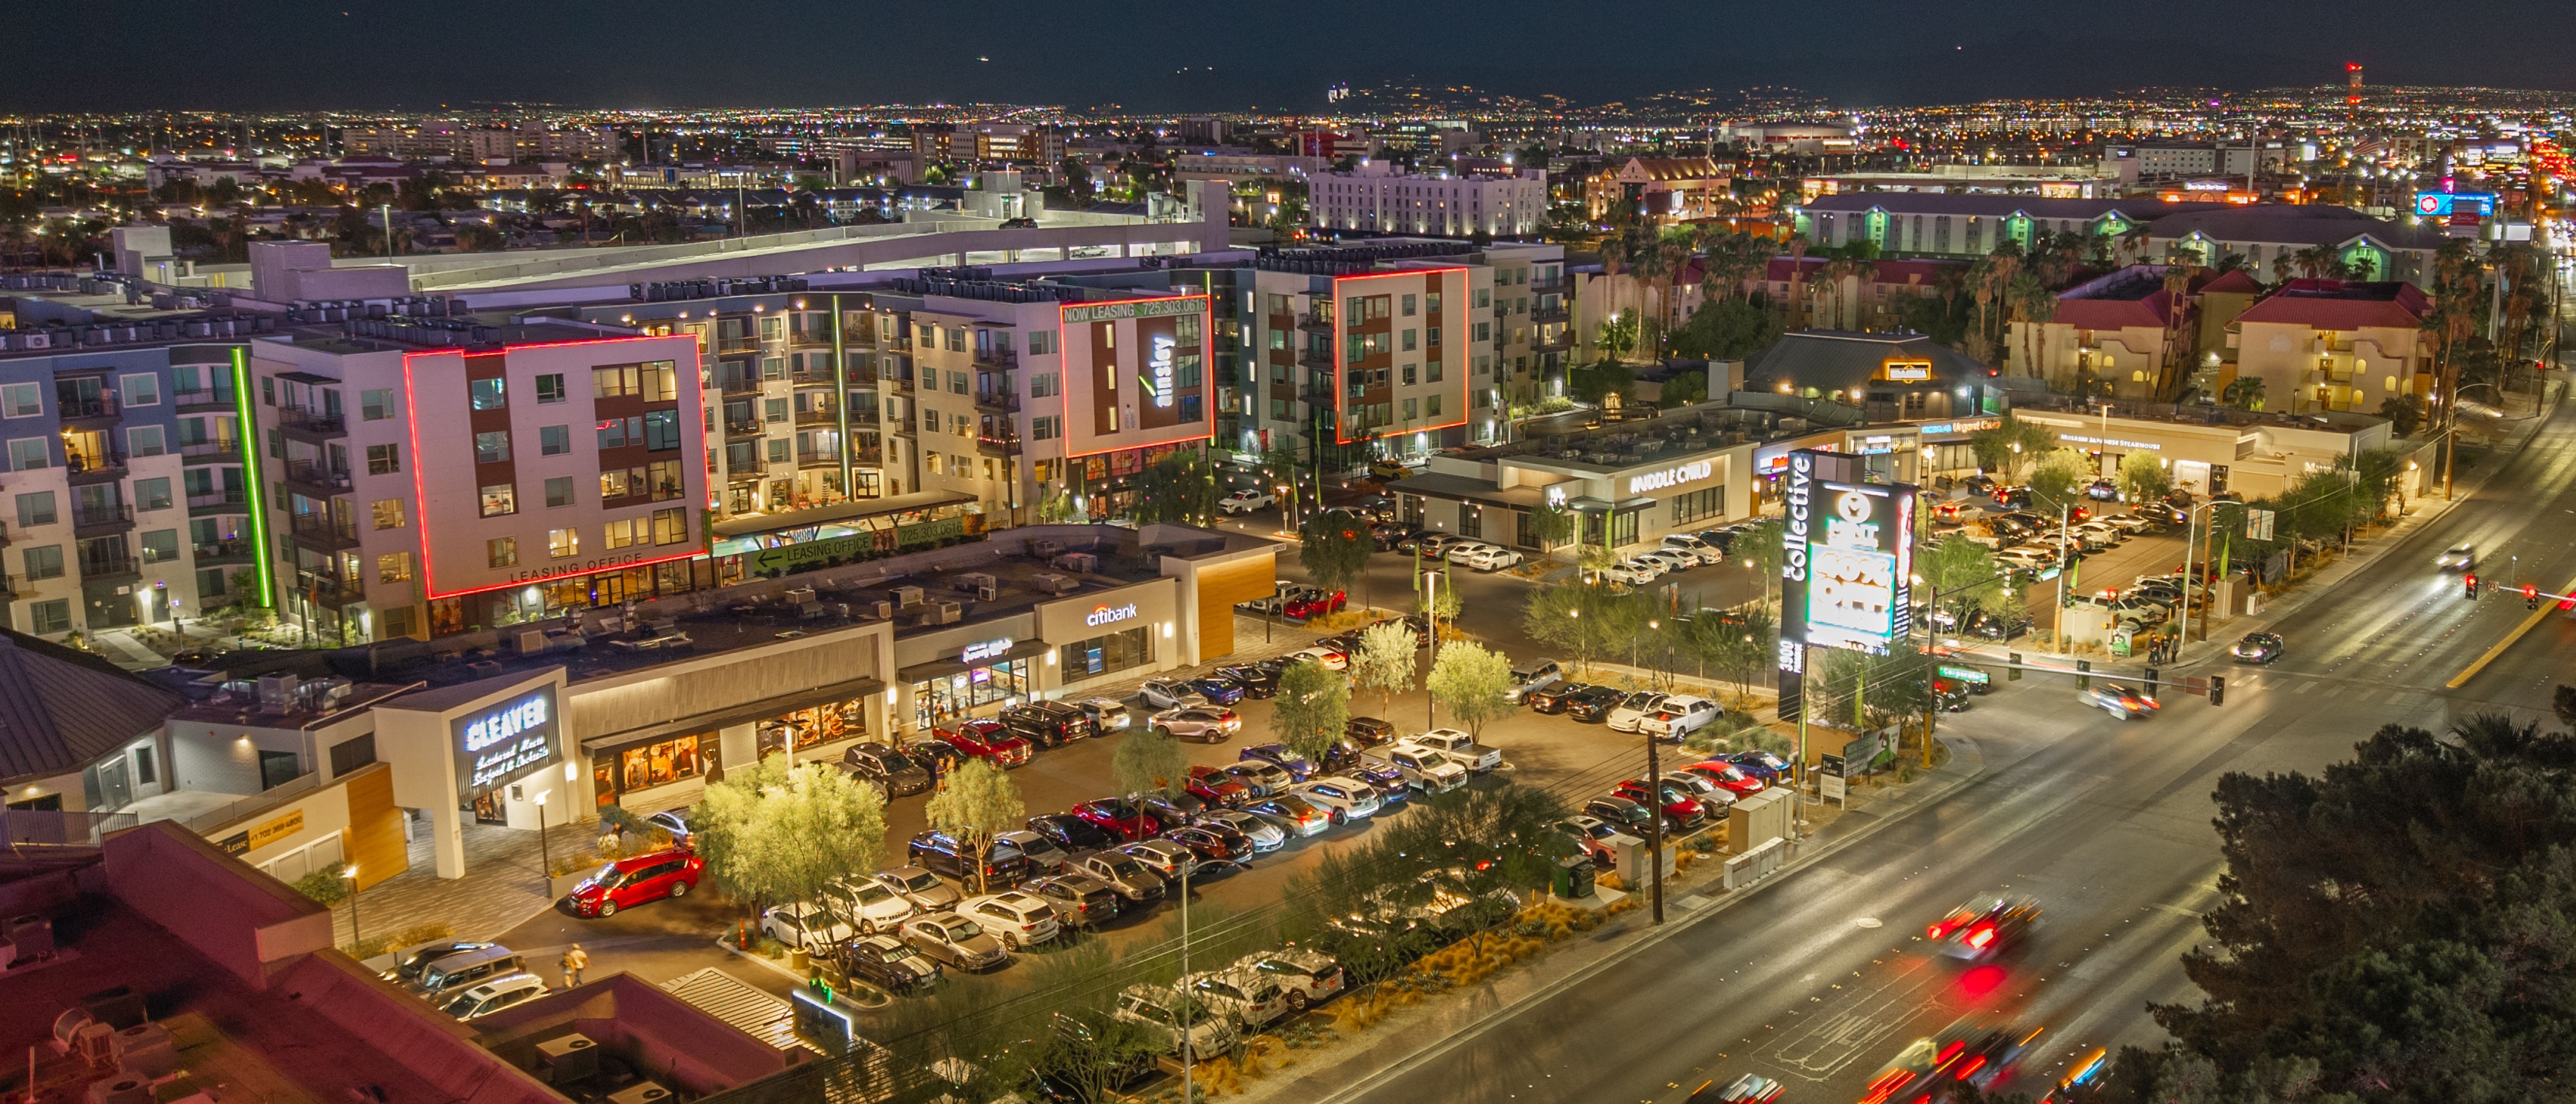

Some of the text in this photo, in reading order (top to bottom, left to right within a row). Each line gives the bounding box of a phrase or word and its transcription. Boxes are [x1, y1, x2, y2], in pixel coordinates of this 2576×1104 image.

[1064, 299, 1206, 321] NOW LEASING 725.303.0616
[1953, 421, 1979, 433] Urgent
[1630, 461, 1711, 494] MIDDLE CHILD
[1784, 456, 1811, 582] collective
[902, 522, 962, 541] 725.303.0616
[787, 537, 869, 562] LEASING OFFICE
[511, 553, 642, 583] LEASING OFFICE
[1087, 603, 1137, 626] citibank
[466, 698, 546, 751] CLEAVER
[259, 829, 271, 839] 702
